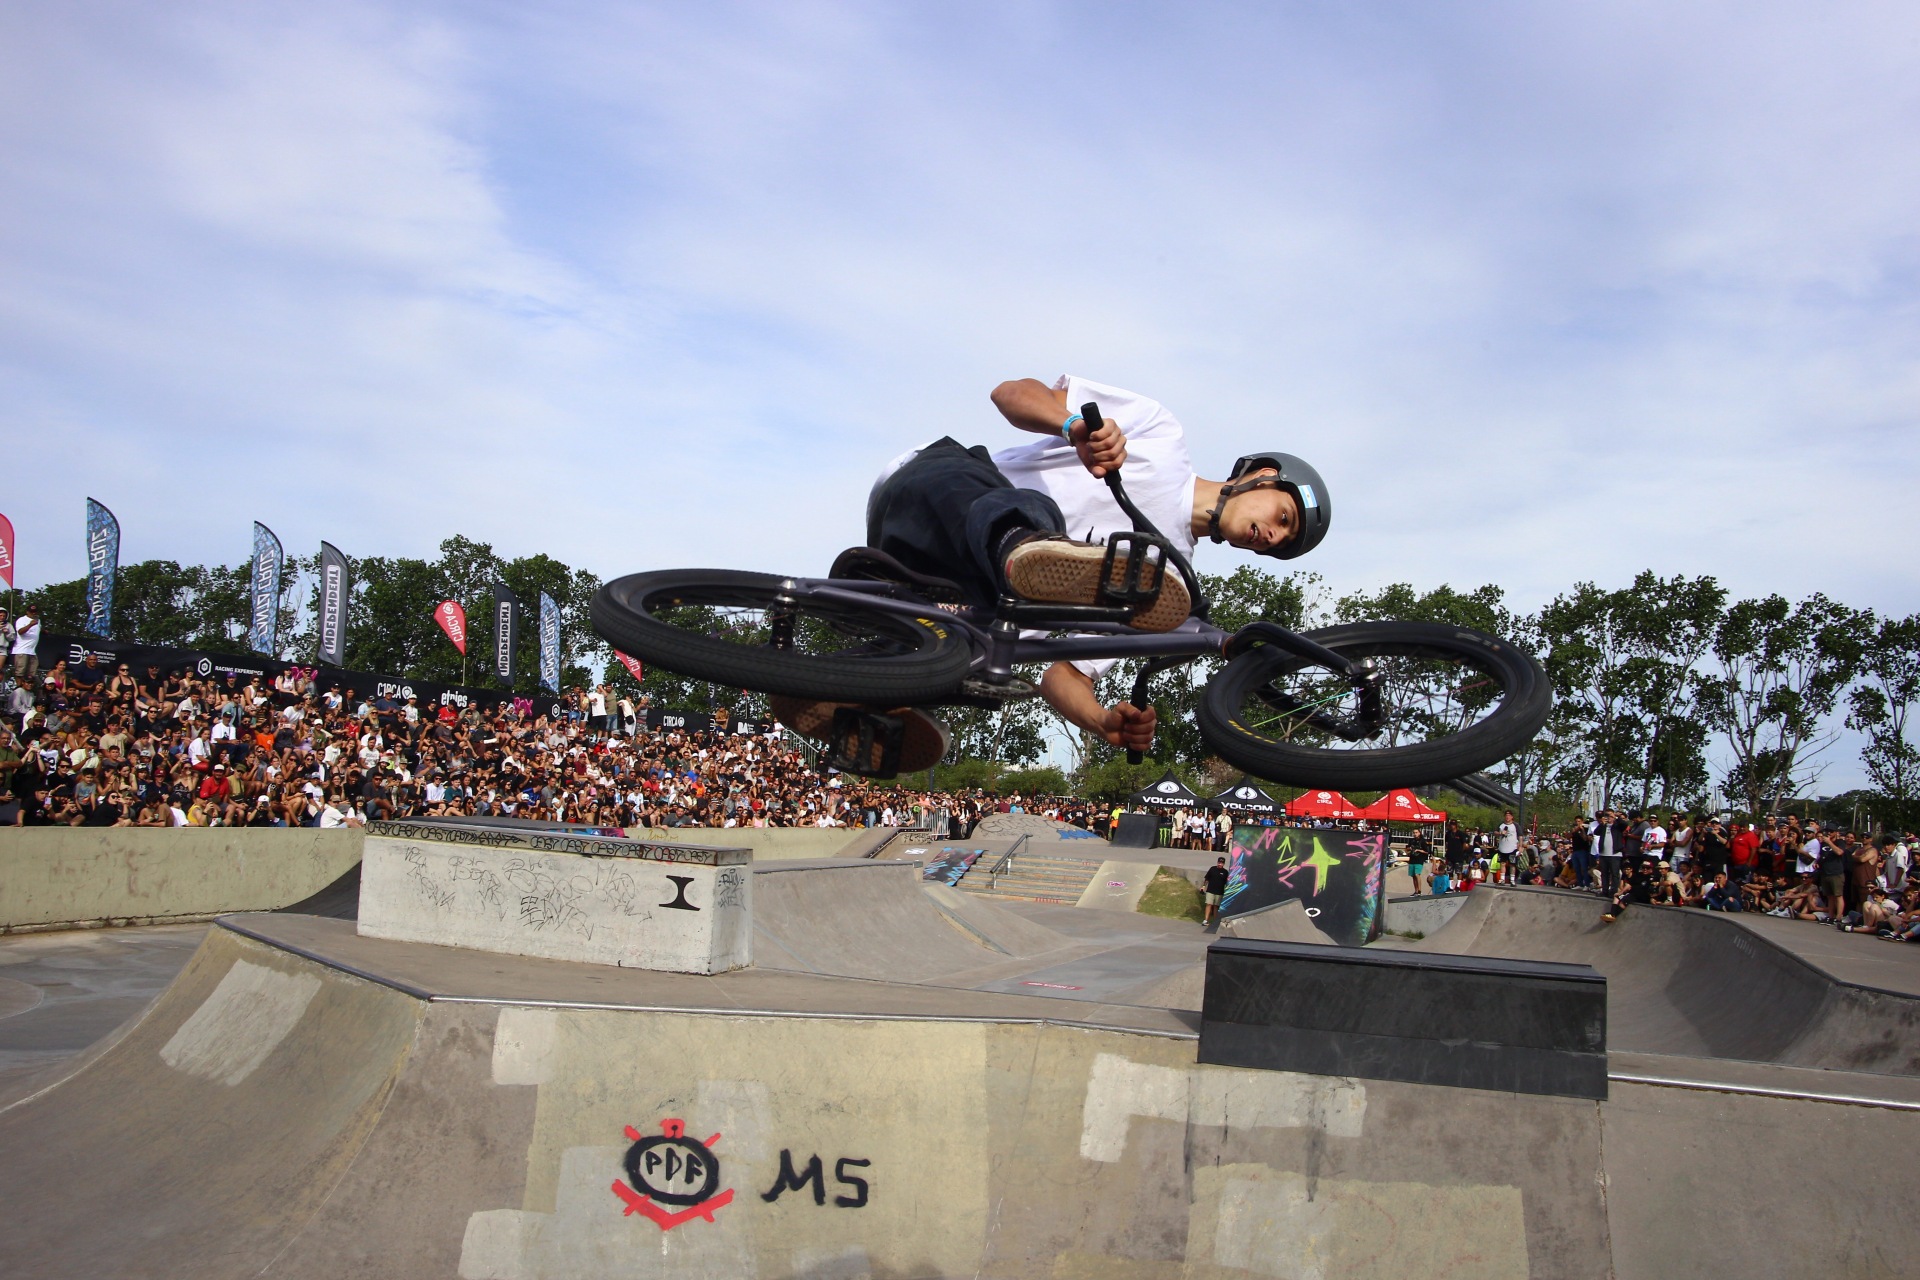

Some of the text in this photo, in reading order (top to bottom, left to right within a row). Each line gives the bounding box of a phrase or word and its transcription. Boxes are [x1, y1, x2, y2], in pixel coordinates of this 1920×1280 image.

[441, 689, 468, 708] etnies
[1142, 795, 1194, 806] VOLCOM
[1220, 801, 1273, 812] VOLCOM
[645, 1147, 703, 1185] PDF
[760, 1148, 872, 1208] MS
